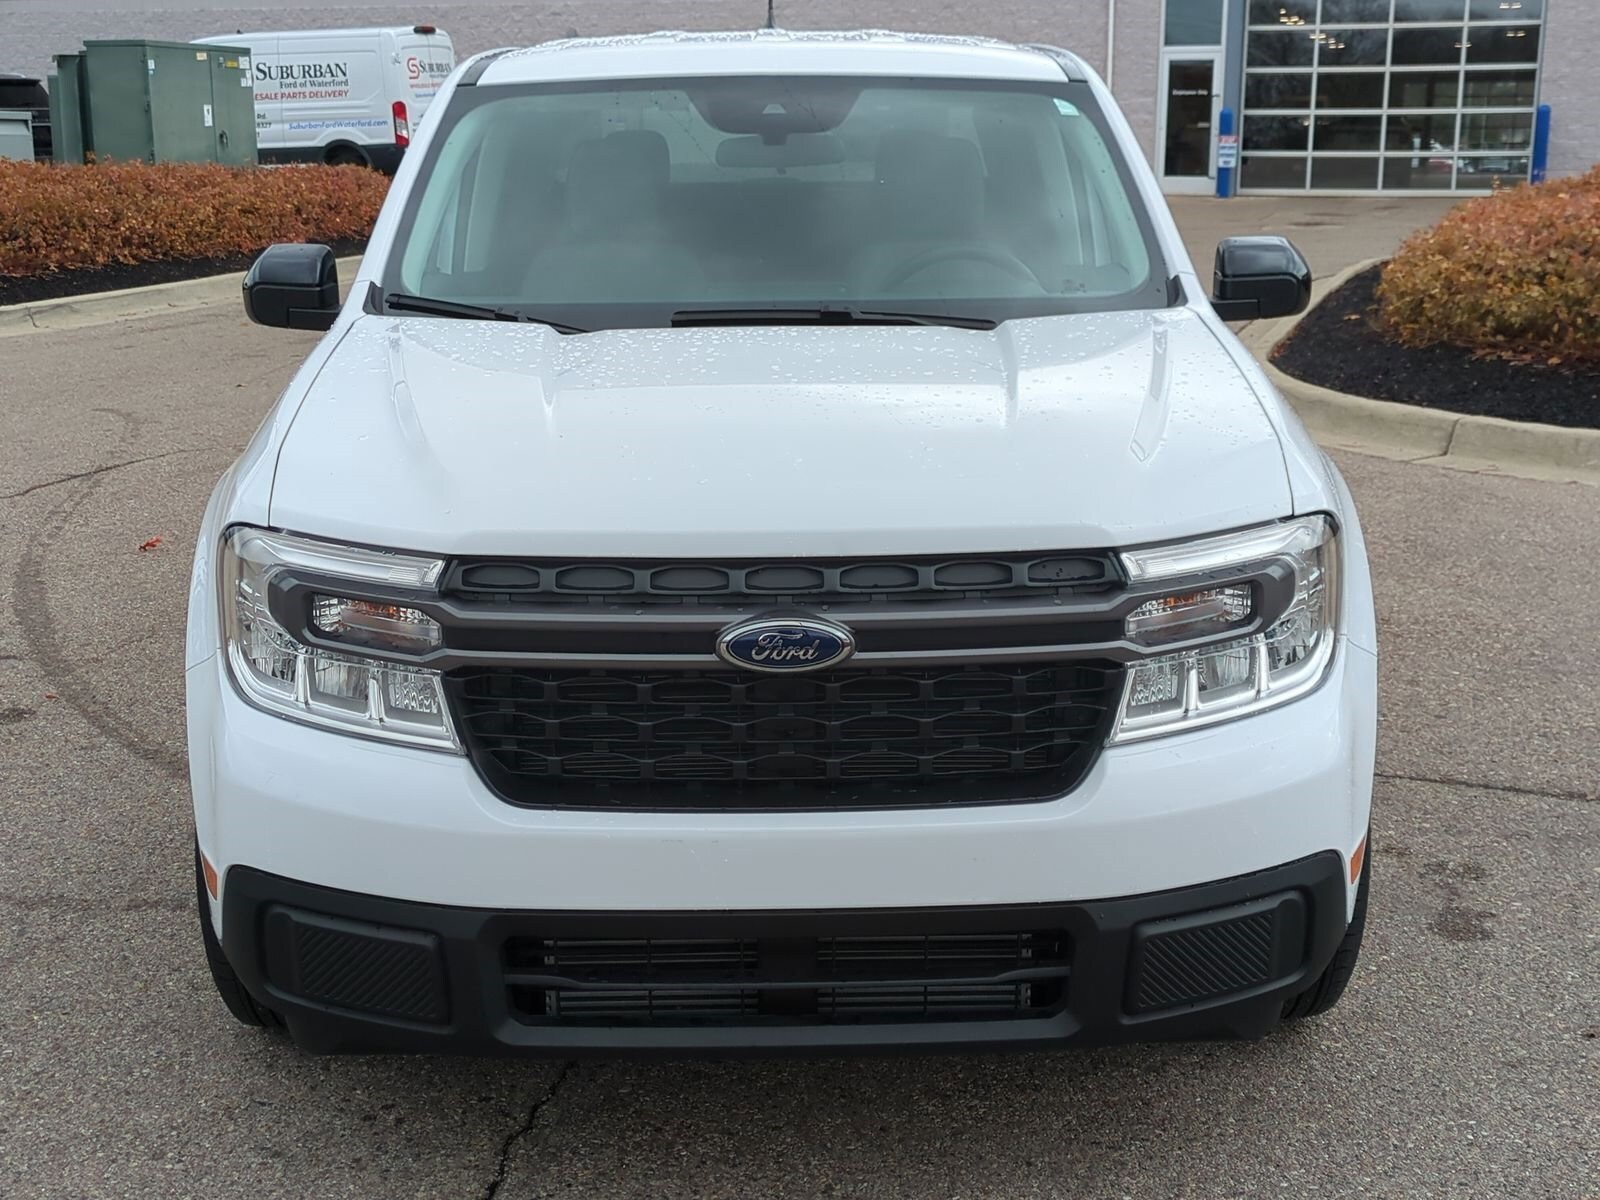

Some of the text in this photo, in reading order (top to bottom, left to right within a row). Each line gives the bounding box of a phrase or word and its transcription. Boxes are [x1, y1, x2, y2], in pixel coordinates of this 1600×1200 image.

[255, 62, 347, 81] SUBURBAN
[280, 79, 349, 89] Ford of Waterford
[280, 91, 307, 100] PARTS
[309, 89, 349, 99] DELIVERY
[751, 632, 820, 661] Ford
